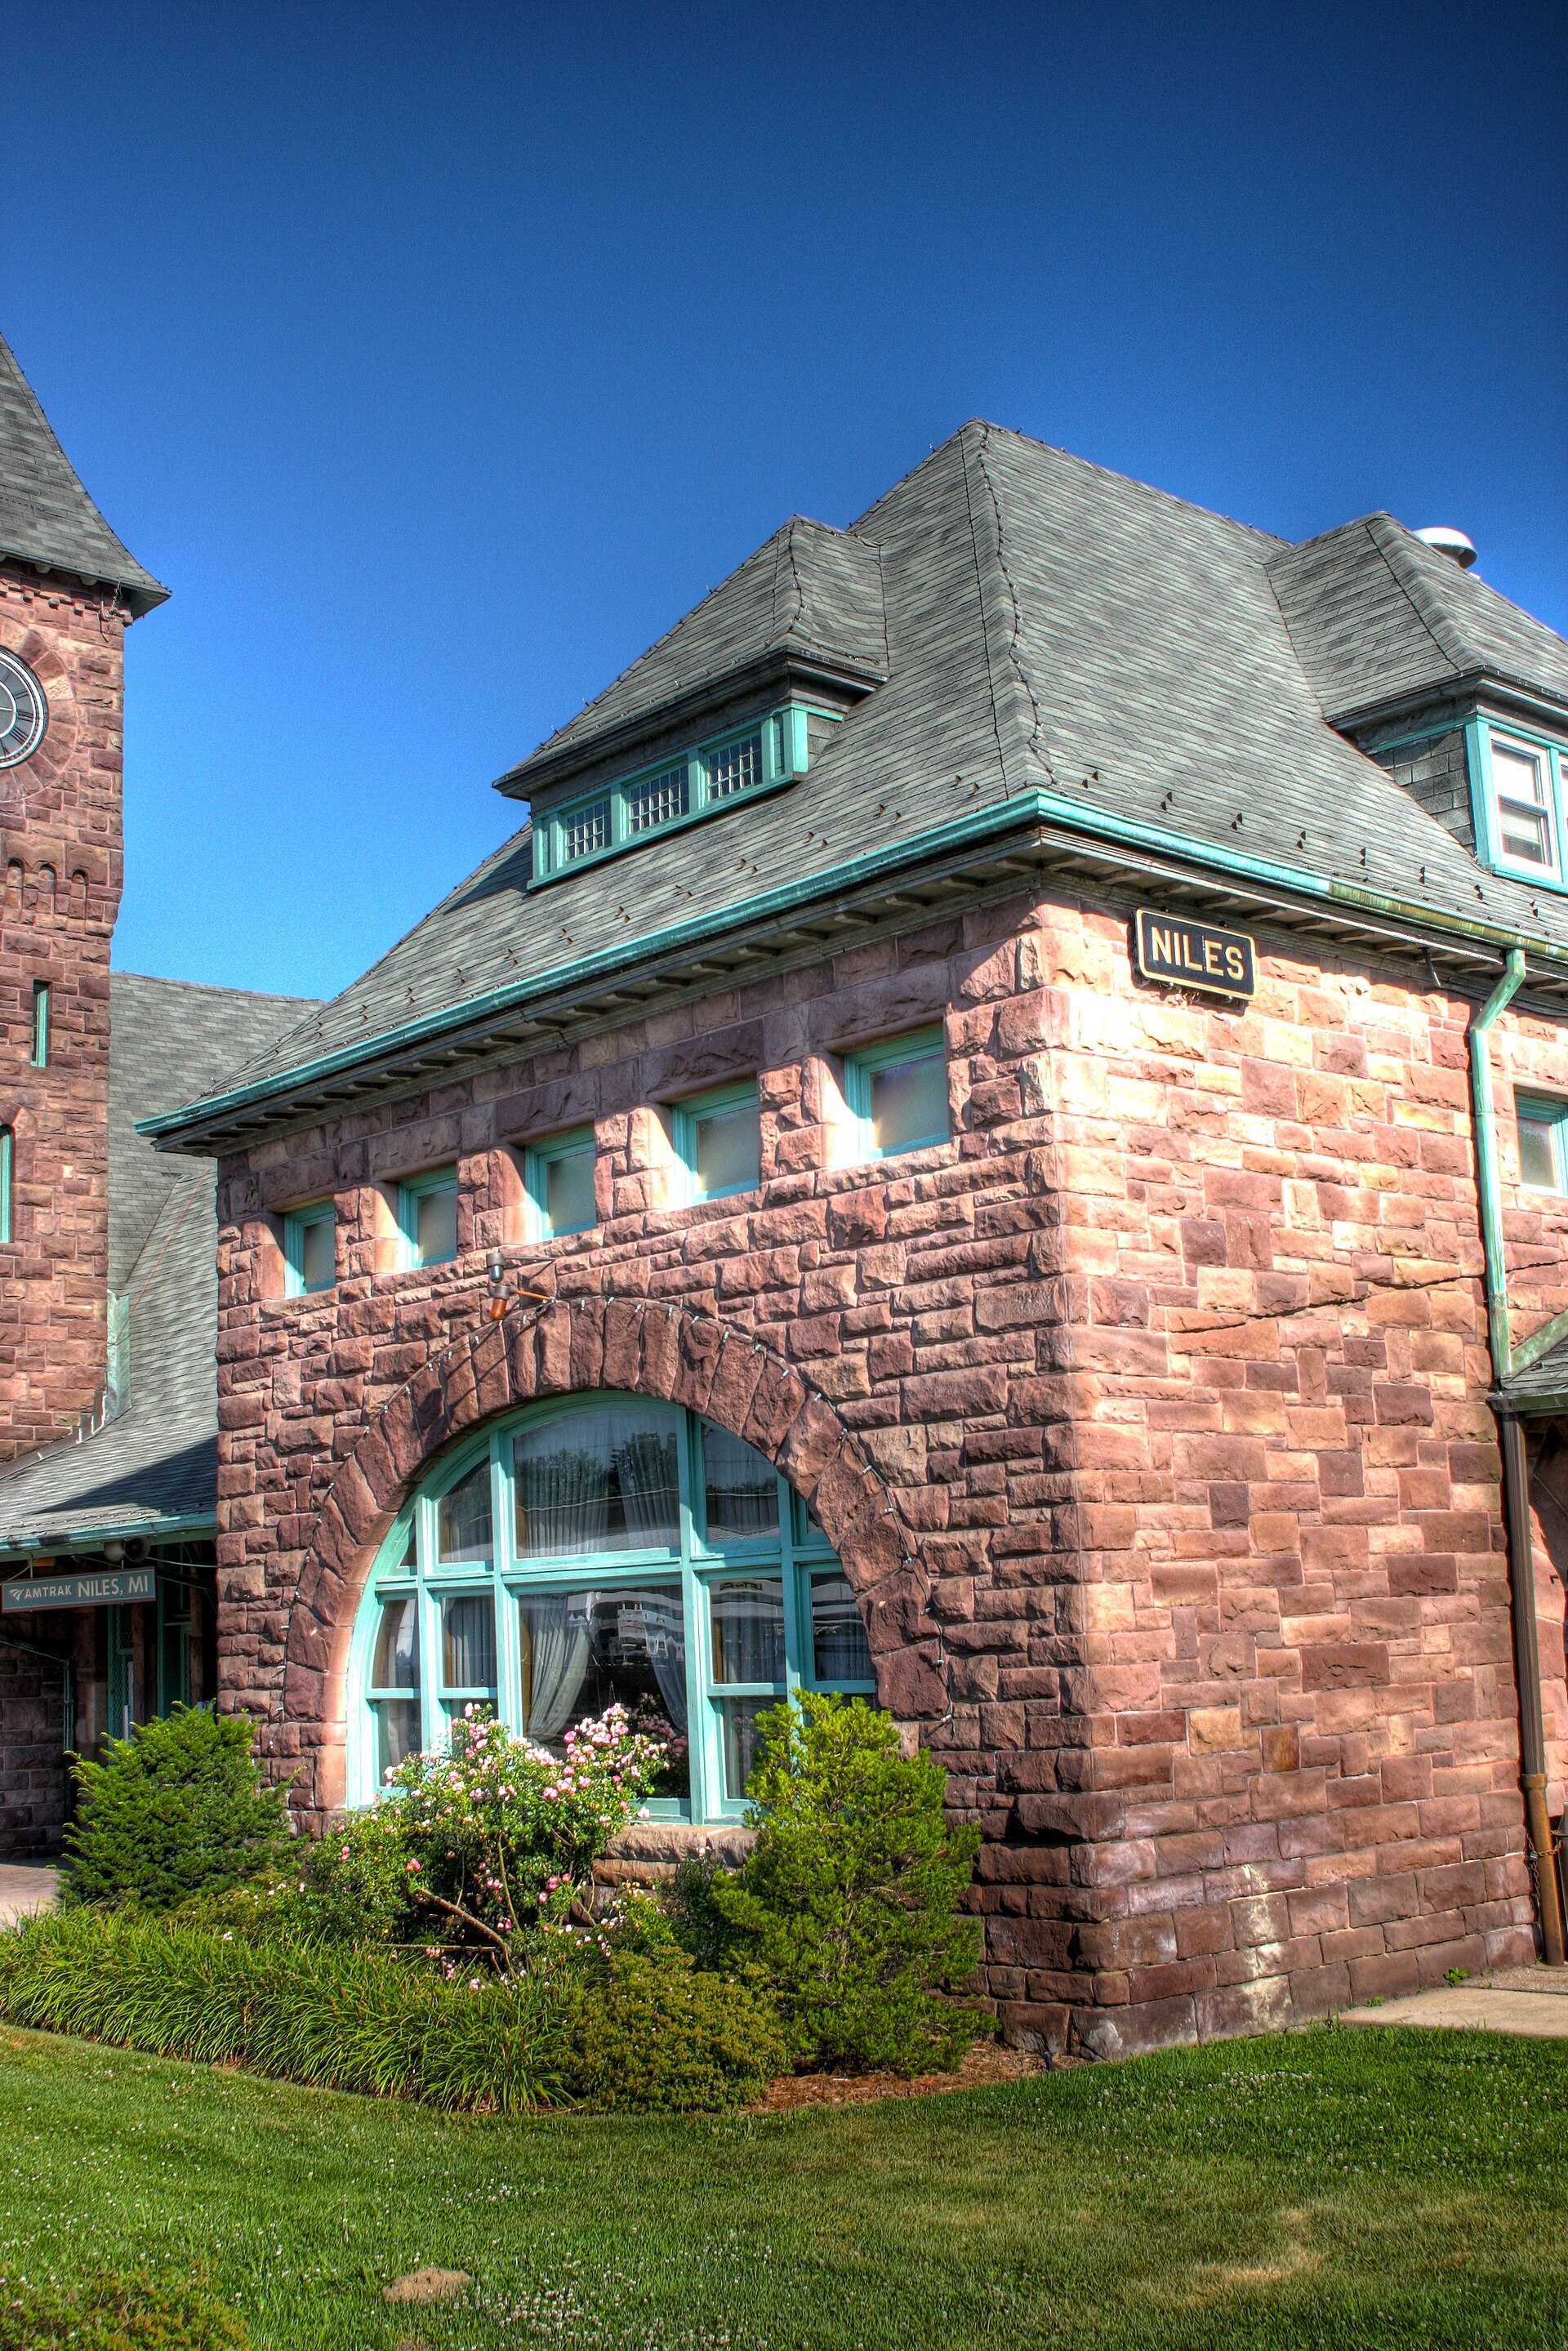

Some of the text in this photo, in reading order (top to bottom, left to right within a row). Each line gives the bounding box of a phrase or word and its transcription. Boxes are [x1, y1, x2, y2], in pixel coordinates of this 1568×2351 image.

[1151, 925, 1245, 981] NILES
[24, 1575, 149, 1599] AMTRAK NILES, MI
